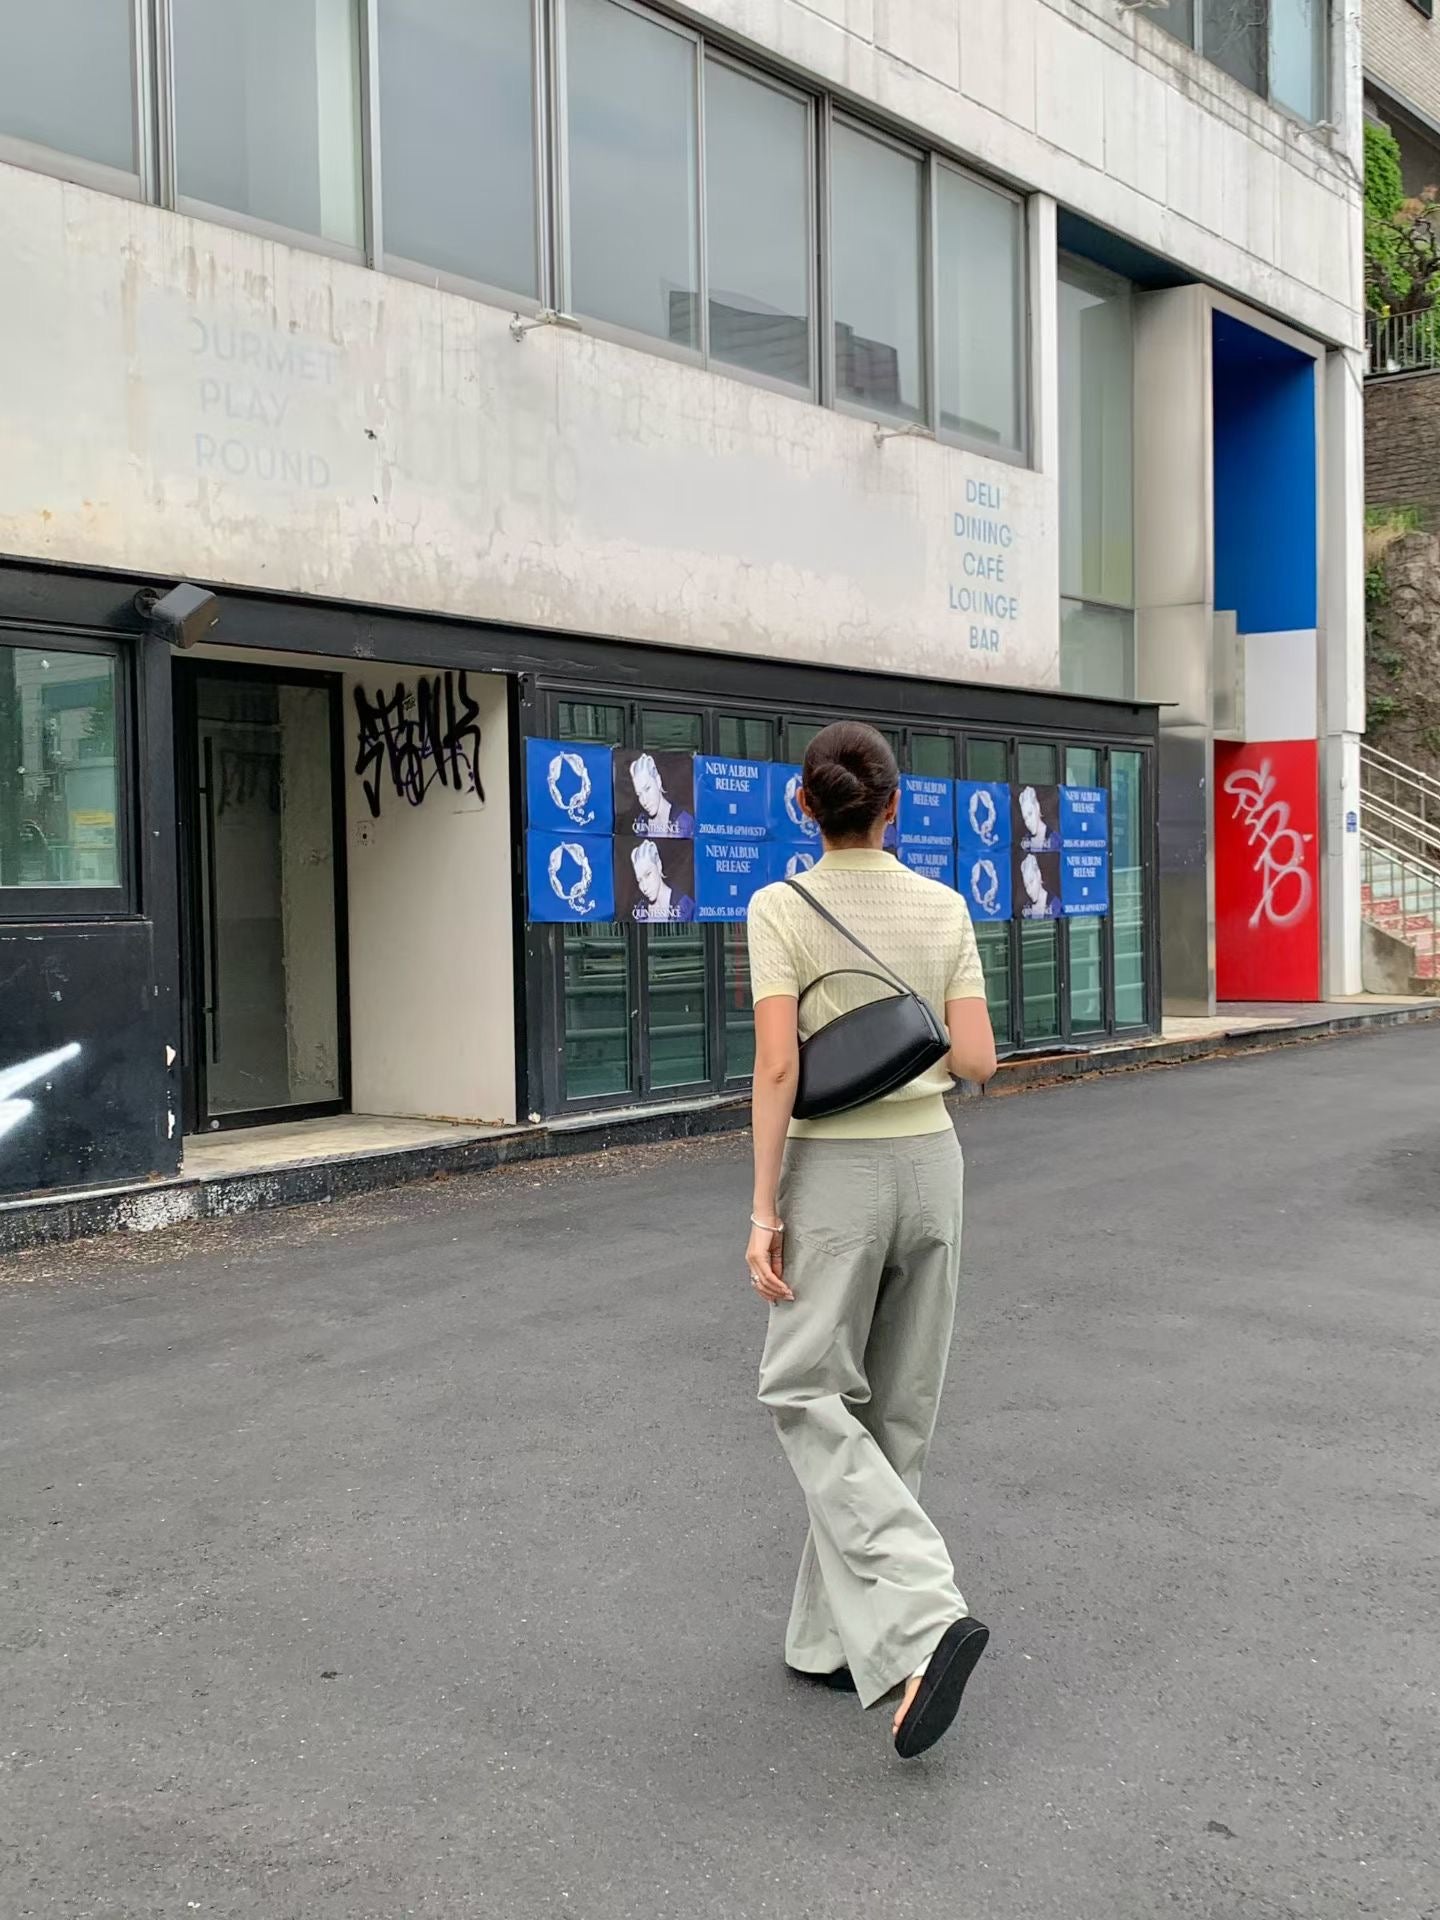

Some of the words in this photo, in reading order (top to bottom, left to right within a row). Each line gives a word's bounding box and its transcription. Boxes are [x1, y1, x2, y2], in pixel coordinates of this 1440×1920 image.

[199, 378, 289, 428] PLAY
[966, 479, 1000, 509] DELI
[954, 512, 1012, 547] DINING
[963, 552, 1004, 582] CAFÉ
[949, 584, 1017, 620] LOUNGE
[970, 626, 999, 652] BAR
[706, 762, 727, 776] NEW
[728, 764, 758, 779] ALBUM
[715, 777, 750, 793] RELEASE
[699, 824, 734, 835] 2026.05.18
[706, 845, 727, 858] NEW
[729, 847, 759, 859] ALBUM
[716, 861, 751, 873] RELEASE
[699, 906, 734, 917] 2026.05.18
